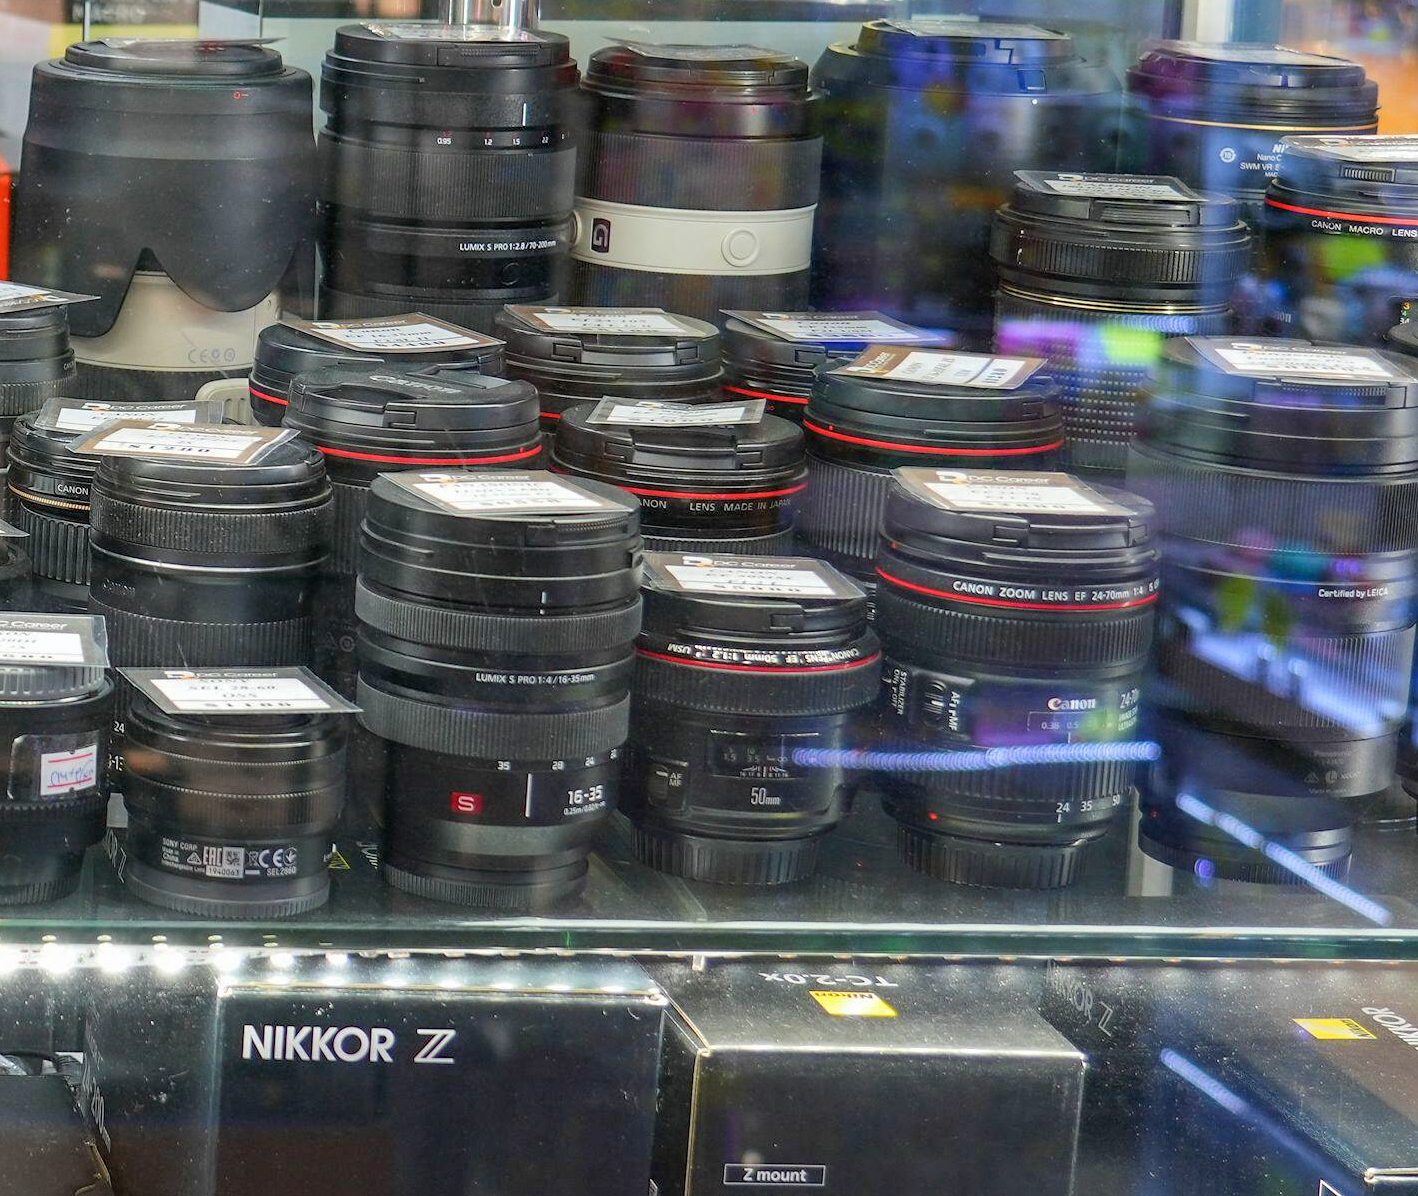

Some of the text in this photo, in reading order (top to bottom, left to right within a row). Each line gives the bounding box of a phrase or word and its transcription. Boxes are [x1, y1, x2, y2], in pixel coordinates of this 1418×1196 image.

[1310, 219, 1418, 238] CANON MACRO LENS
[459, 242, 485, 251] LUMIX
[57, 483, 89, 496] CANON
[689, 501, 754, 512] LENS MADE
[952, 580, 1130, 601] CANON ZOOM LENS 24-70mm
[1317, 587, 1389, 599] Certified LEICA
[475, 672, 507, 684] LUMIX
[1047, 697, 1096, 712] Canon
[567, 784, 604, 805] 16-35
[750, 786, 781, 805] 50mm
[760, 970, 898, 987] TC-2.0x
[241, 1024, 457, 1066] NIKKOR Z
[758, 1168, 807, 1184] mount
